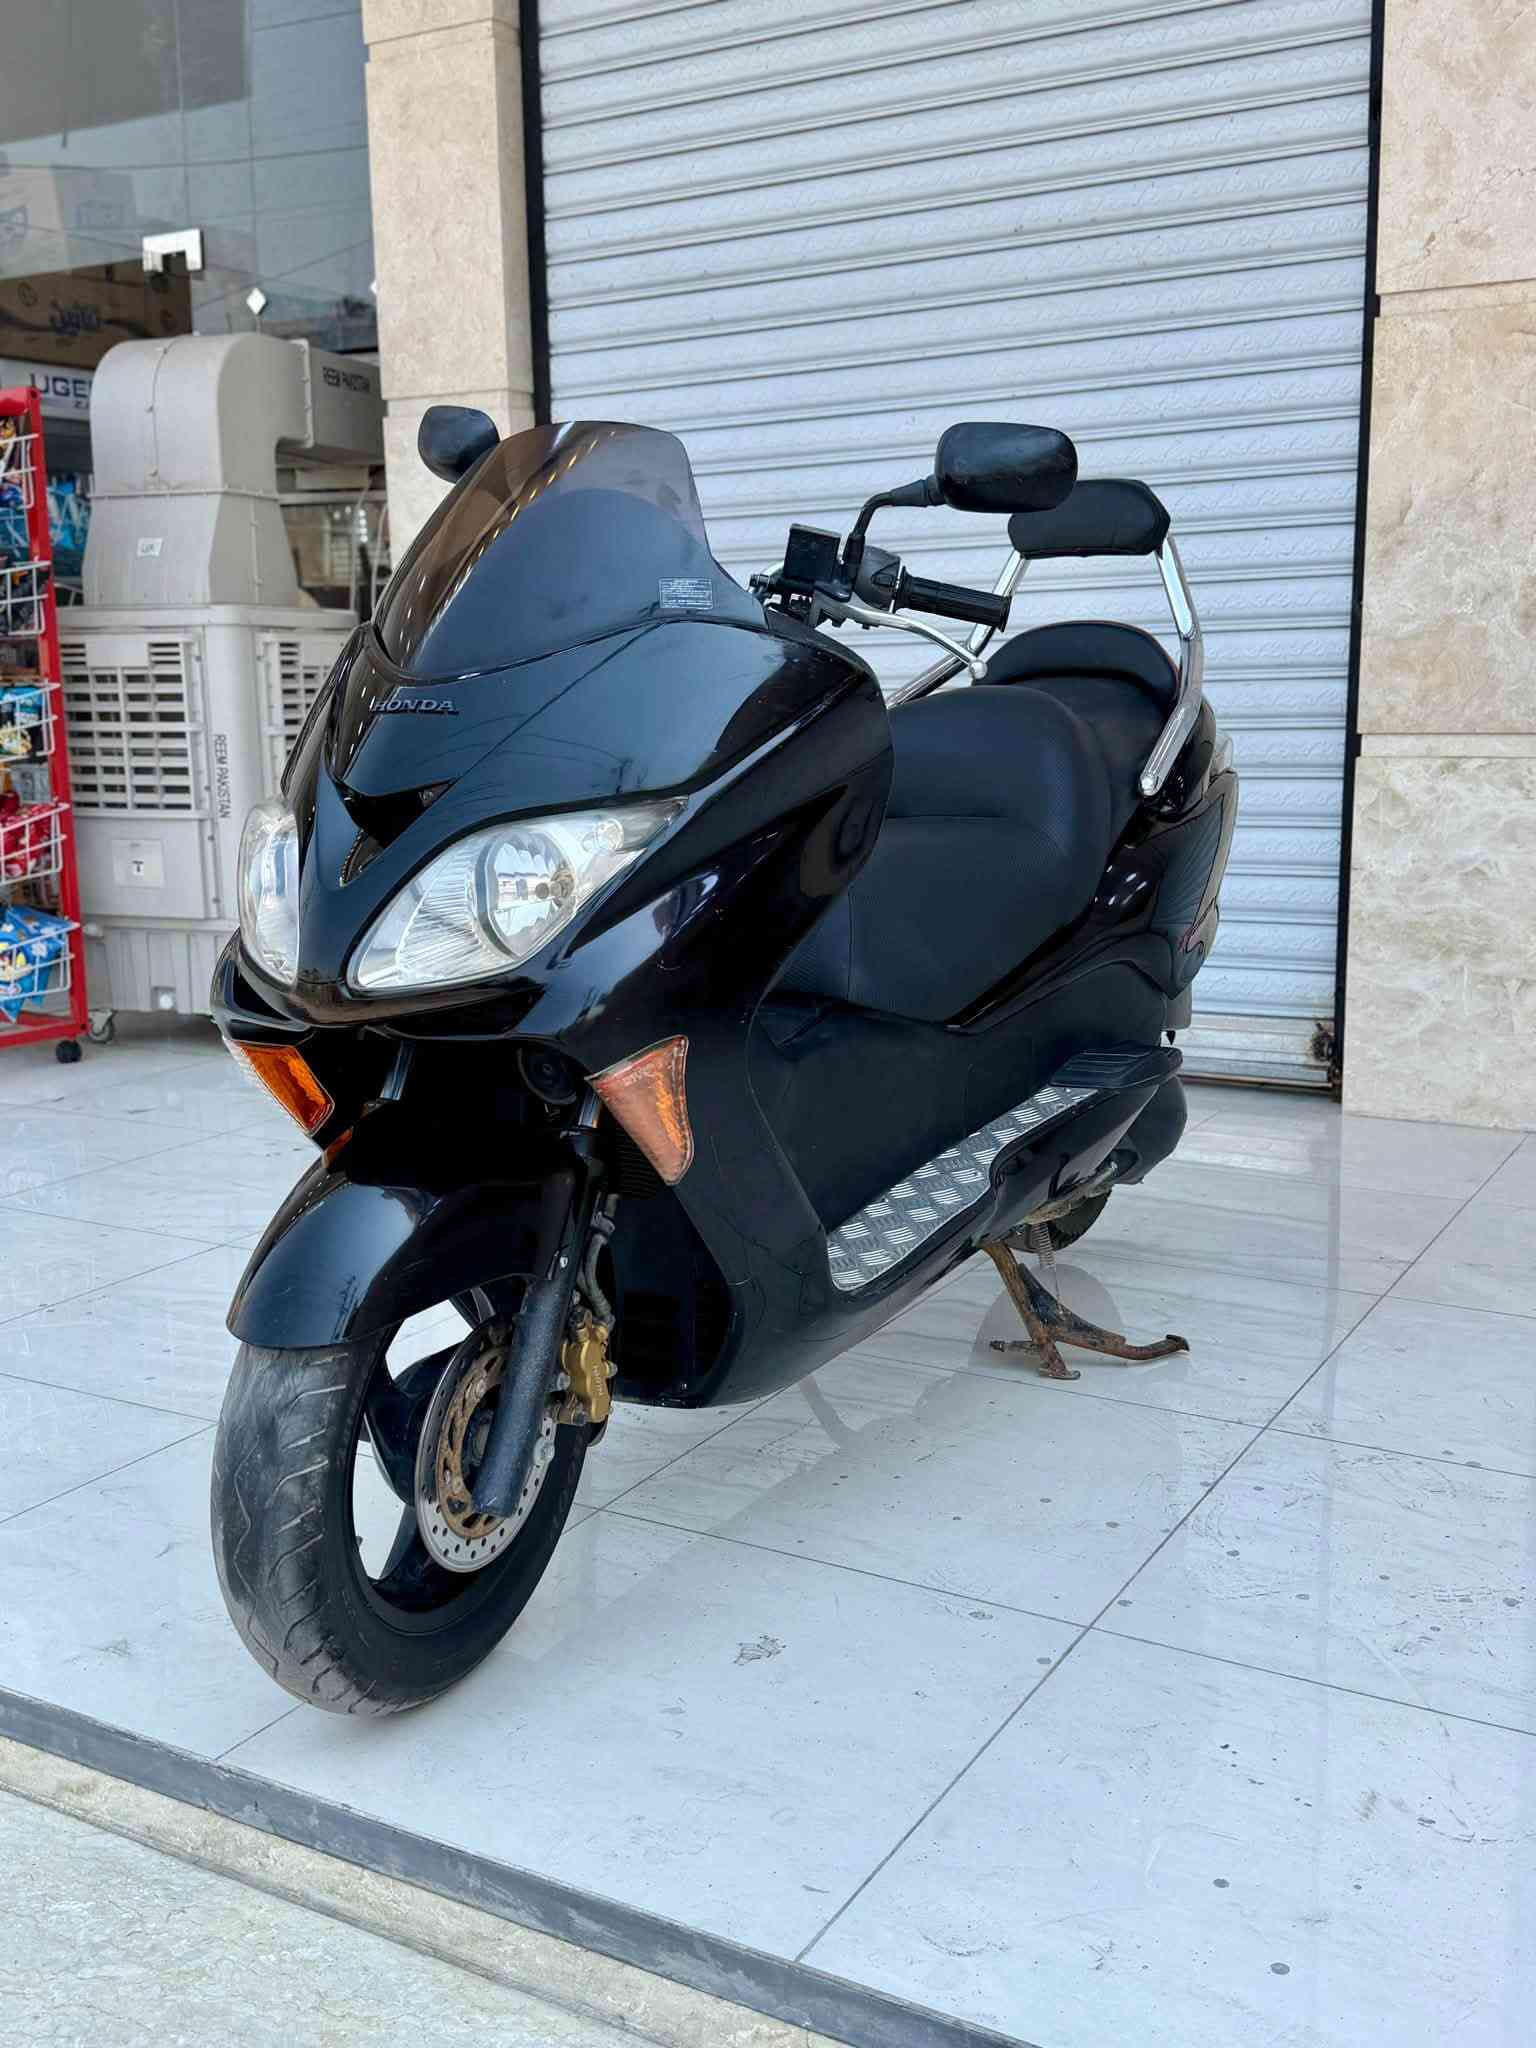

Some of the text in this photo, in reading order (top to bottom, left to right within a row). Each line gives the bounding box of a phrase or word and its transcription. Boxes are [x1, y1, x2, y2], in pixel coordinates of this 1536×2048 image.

[31, 373, 93, 398] UGE
[372, 699, 456, 712] HONDA
[215, 734, 232, 818] REEM PAKISTAN
